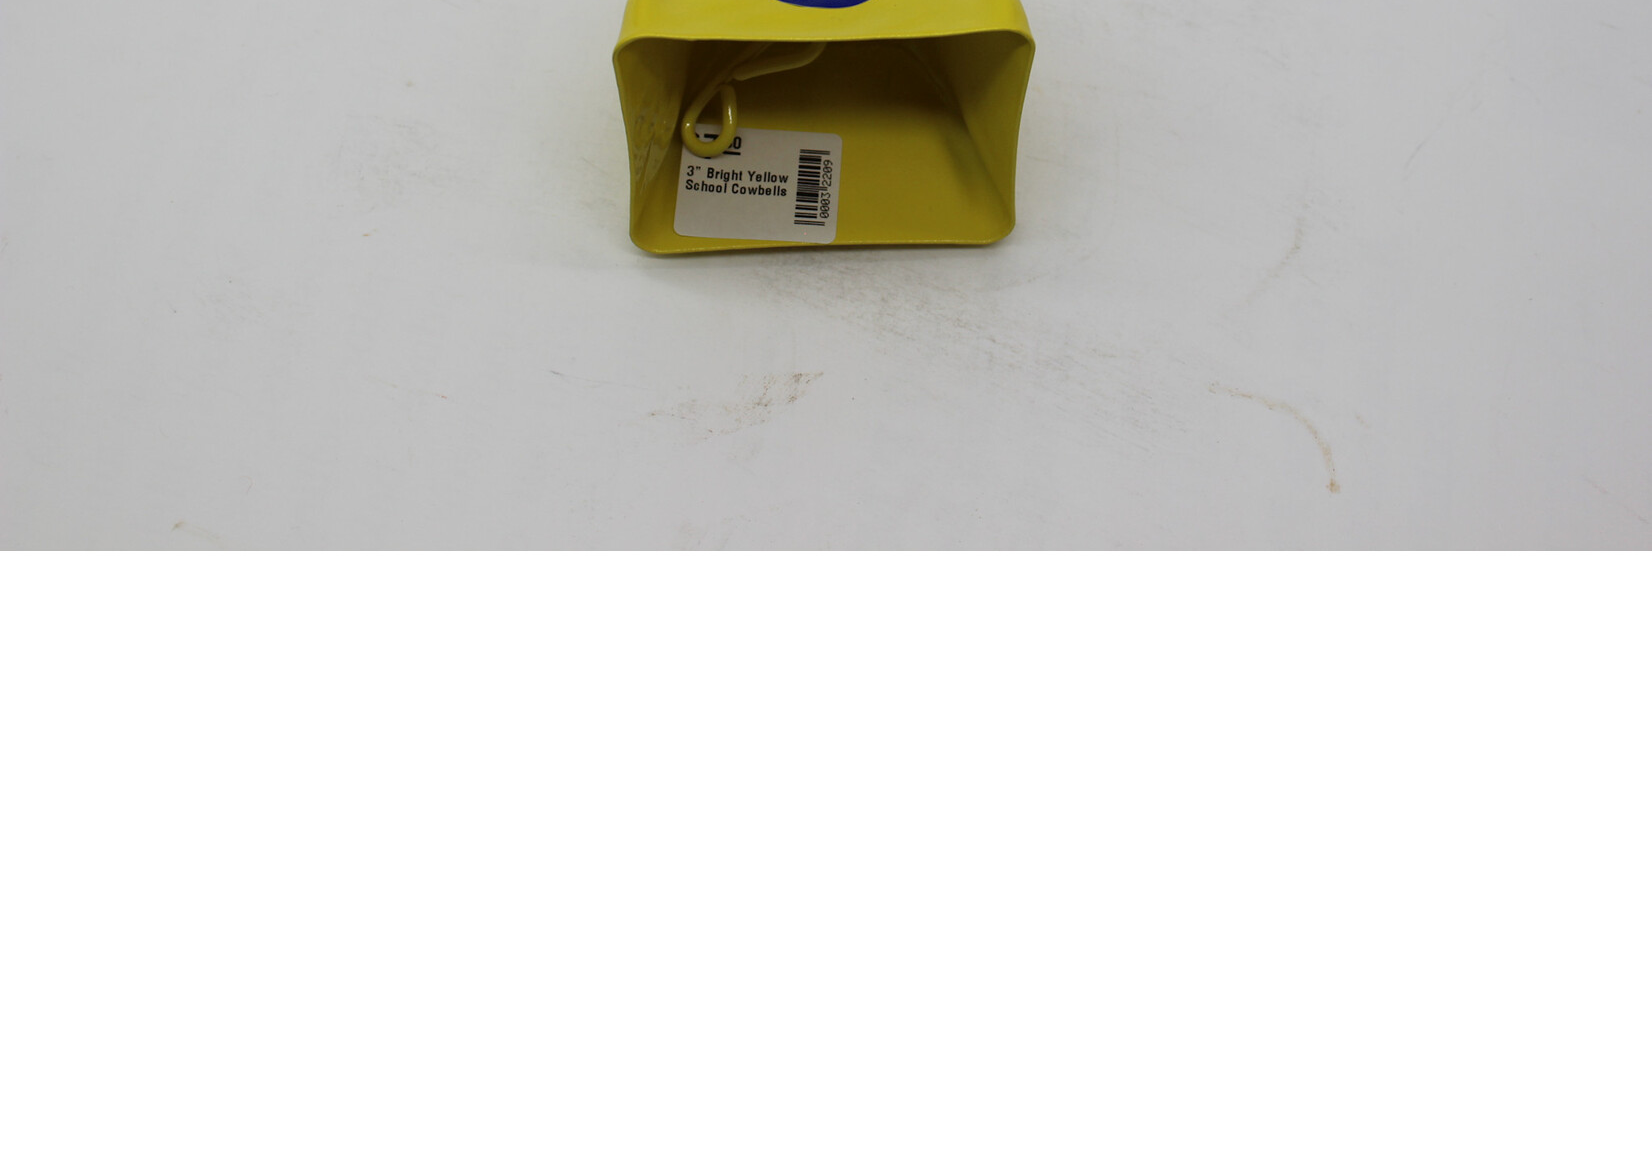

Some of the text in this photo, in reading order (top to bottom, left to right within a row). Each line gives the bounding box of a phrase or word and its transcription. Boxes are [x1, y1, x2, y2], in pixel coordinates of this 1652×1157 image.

[706, 167, 743, 182] Bright
[747, 170, 789, 184] Yellow
[685, 179, 788, 196] School Cowbells
